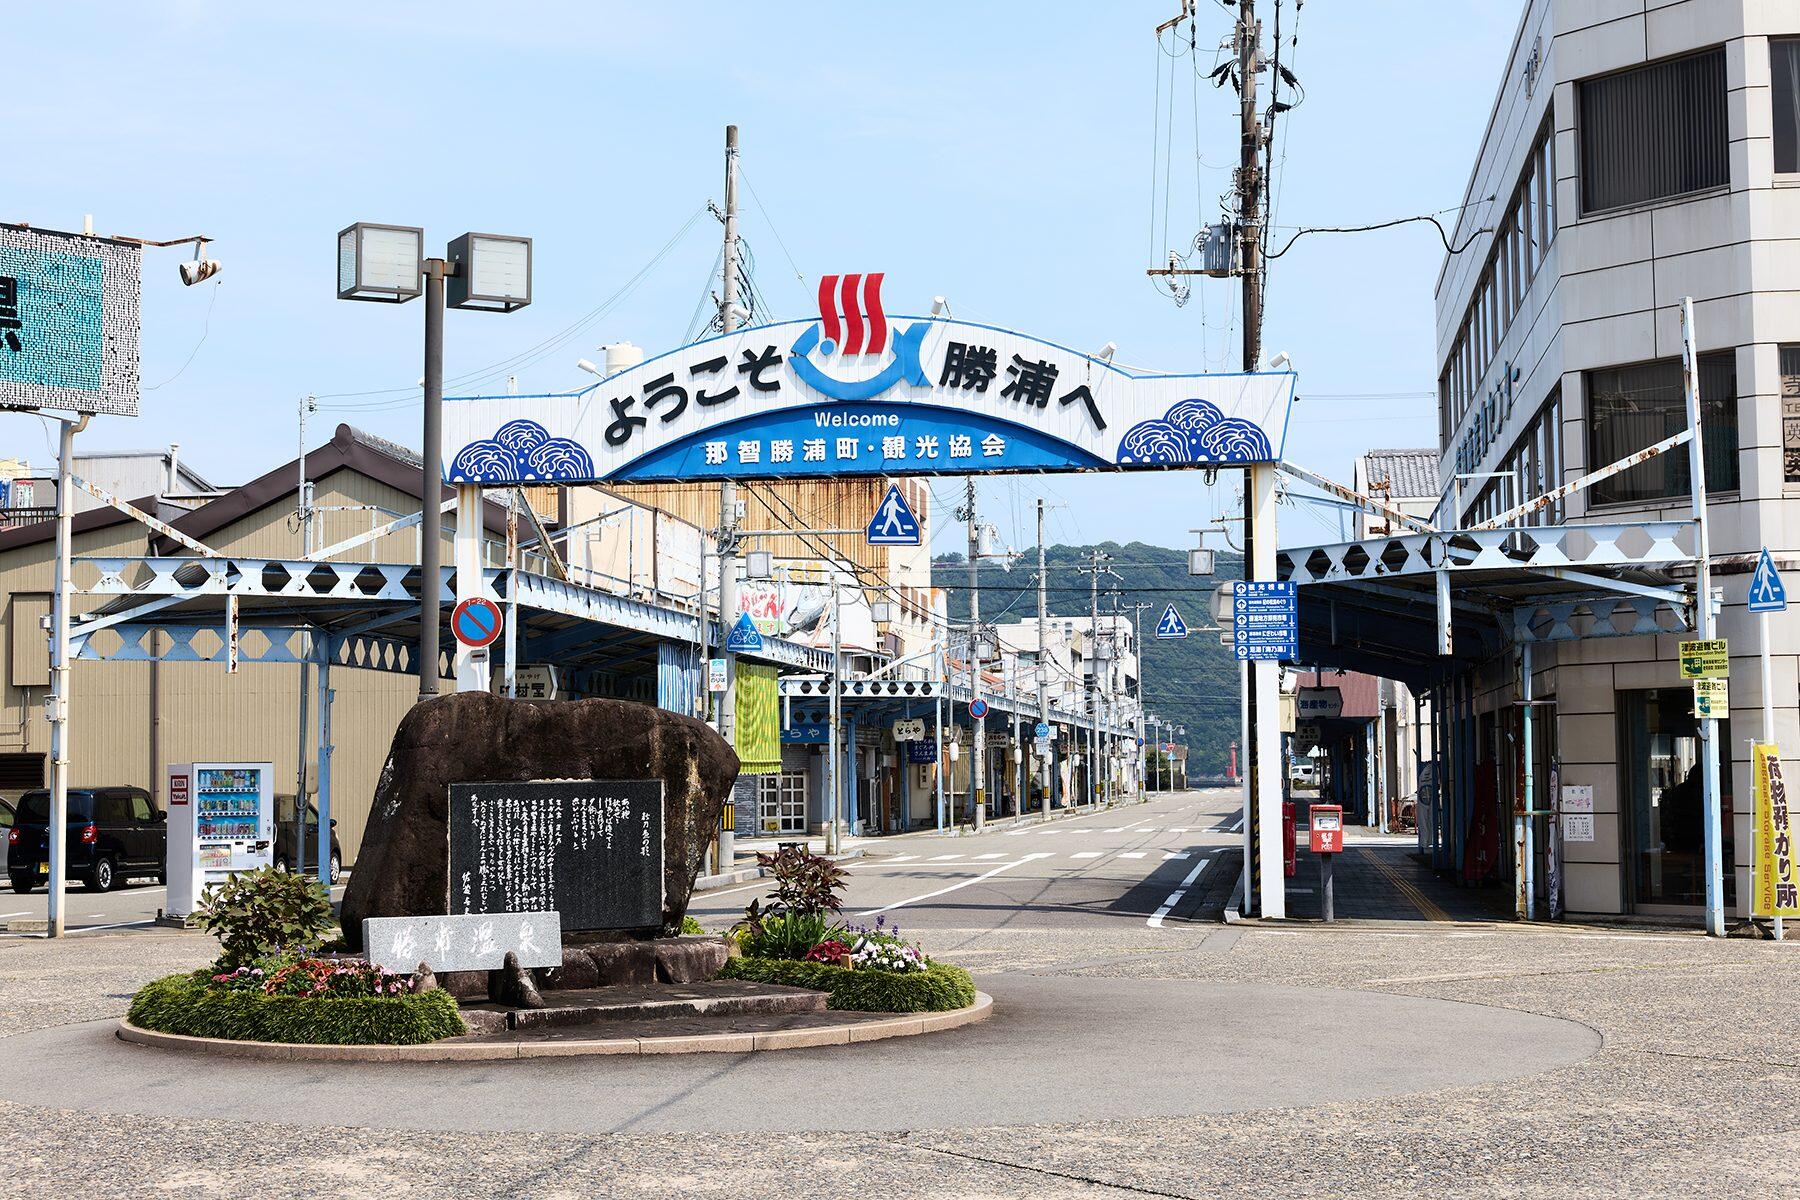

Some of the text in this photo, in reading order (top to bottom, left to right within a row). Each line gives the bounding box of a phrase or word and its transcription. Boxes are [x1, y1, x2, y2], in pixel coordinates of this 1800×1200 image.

[604, 341, 1107, 446] ようこそ 勝浦へ
[815, 411, 899, 427] Welcome
[705, 434, 1006, 465] 那智勝浦町・観光協会
[1681, 641, 1726, 651] 津波避難ビル
[897, 727, 921, 735] とらや
[1764, 864, 1772, 910] Service
